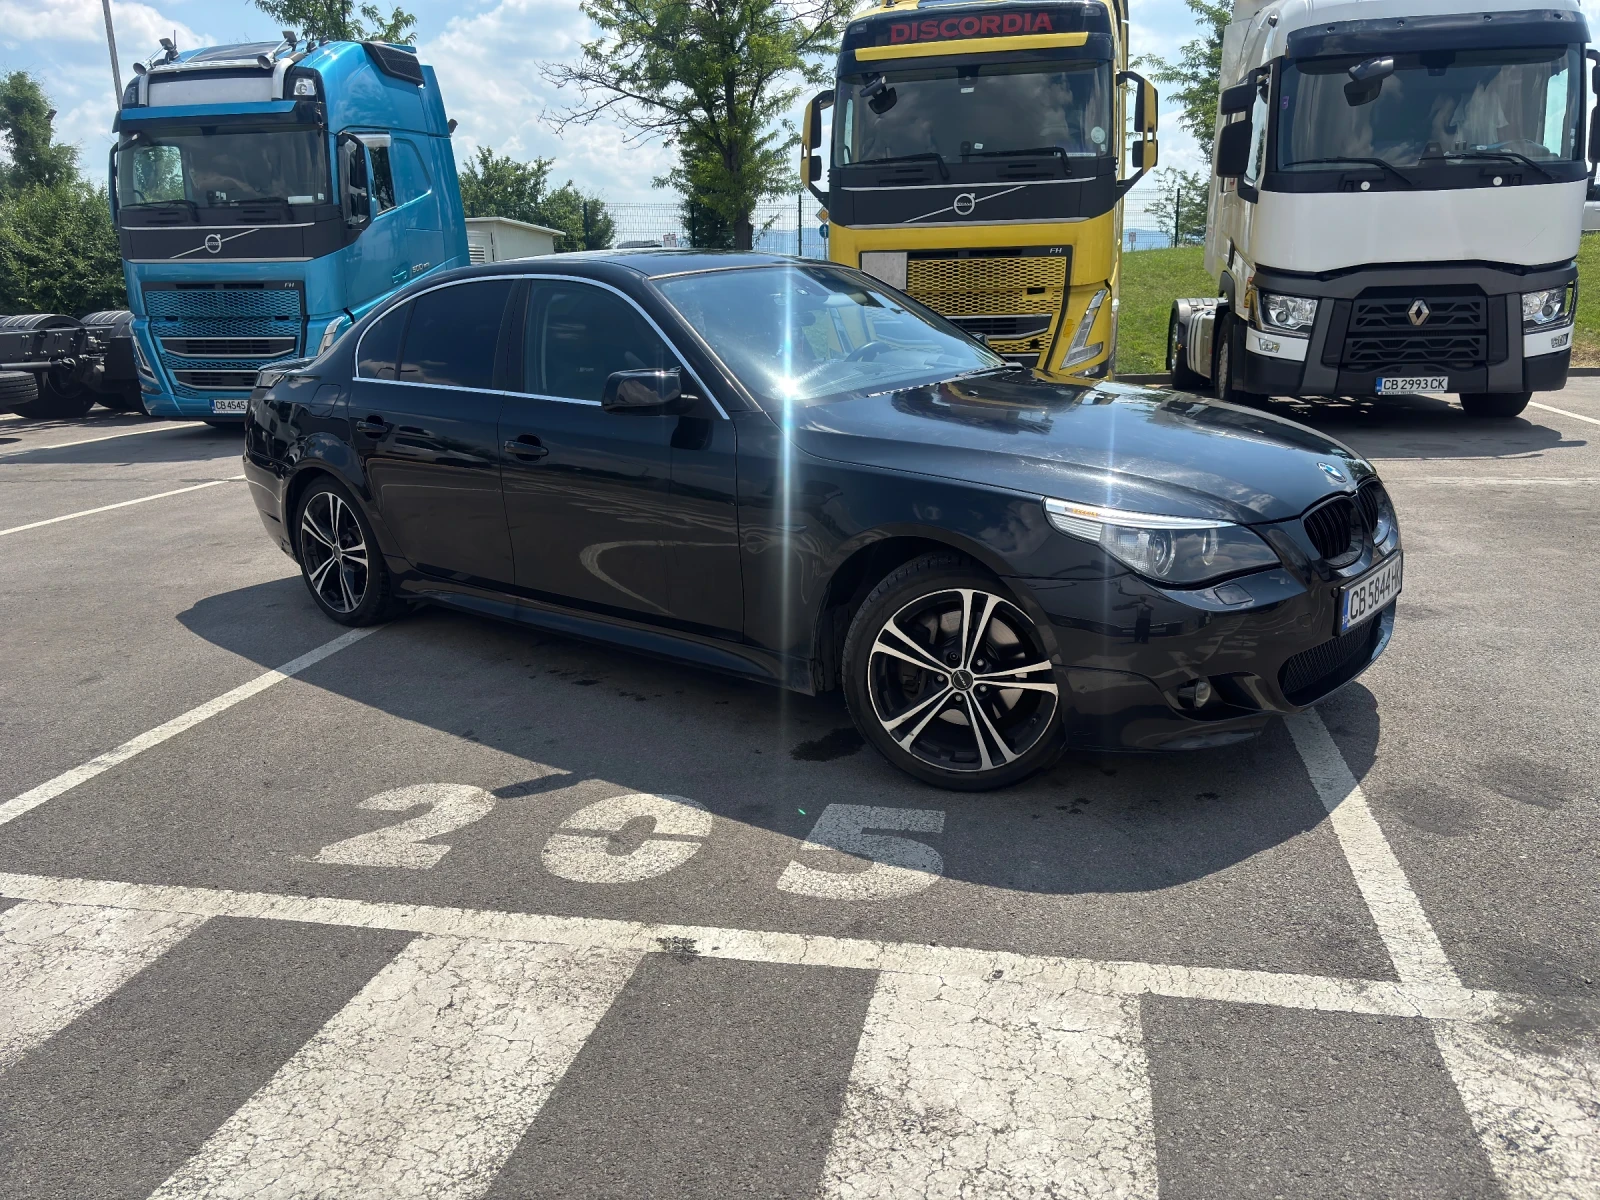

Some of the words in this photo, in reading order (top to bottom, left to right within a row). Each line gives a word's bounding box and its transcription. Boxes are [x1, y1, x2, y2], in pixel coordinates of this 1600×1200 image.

[890, 12, 1053, 43] DISCORDIA
[1383, 379, 1399, 390] CB
[1400, 379, 1428, 390] 2993
[1430, 378, 1446, 390] CK
[215, 400, 226, 410] CB
[227, 400, 246, 410] 4545
[1350, 586, 1366, 620] CB
[1368, 567, 1390, 610] 5844
[310, 783, 947, 900] 205
